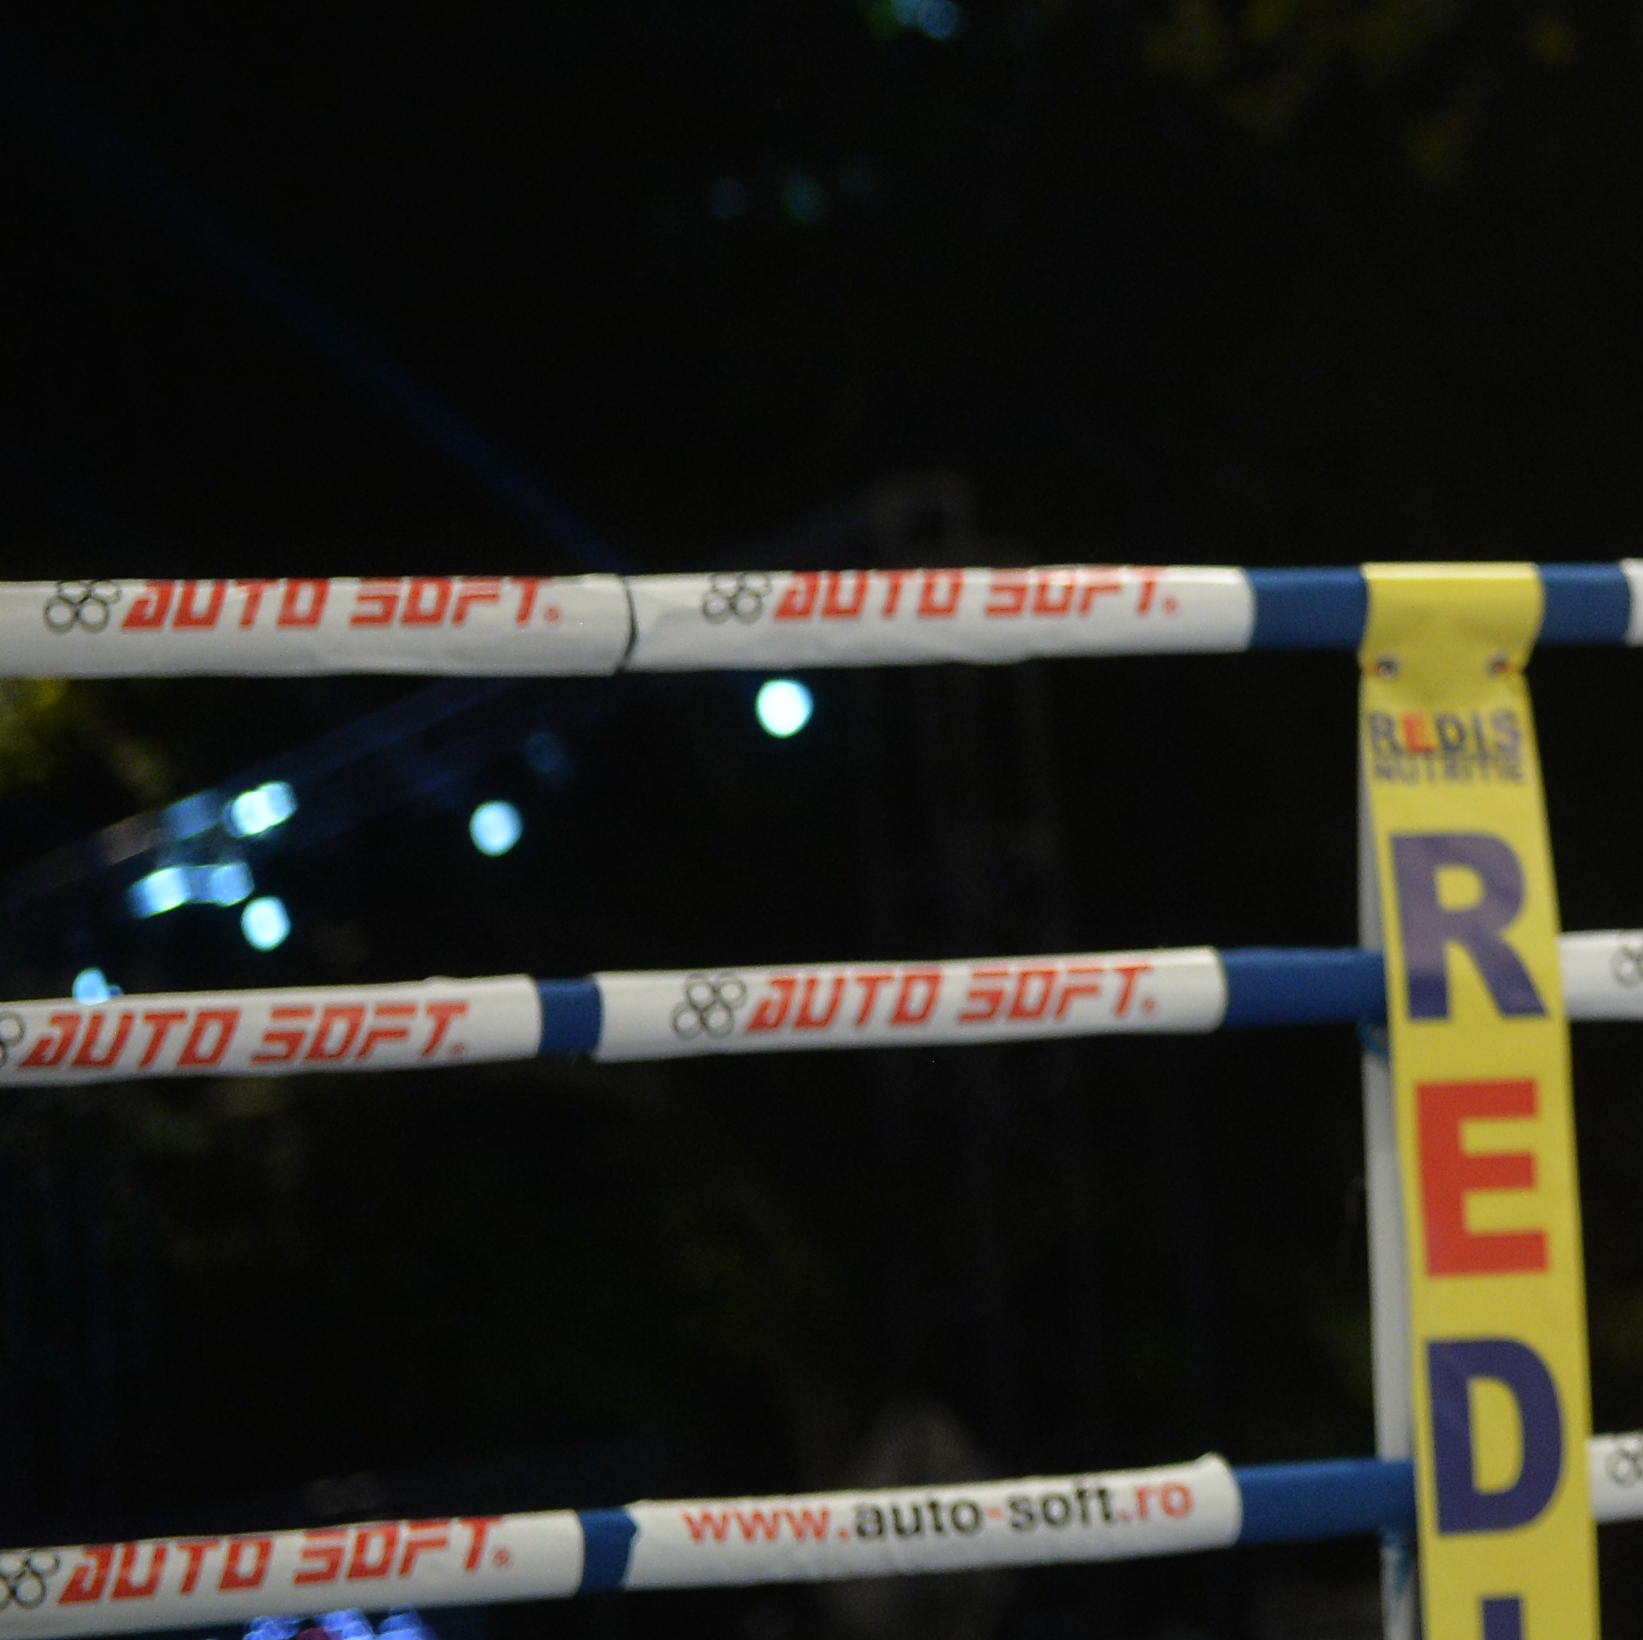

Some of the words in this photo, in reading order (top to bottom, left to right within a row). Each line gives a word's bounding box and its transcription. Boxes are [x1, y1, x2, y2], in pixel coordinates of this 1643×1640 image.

[122, 578, 330, 630] AUTO
[349, 576, 559, 627] SOFT
[773, 568, 964, 622] AUTO
[984, 566, 1163, 618] SOFT
[745, 965, 939, 1033] AUTO
[957, 961, 1154, 1023] SOFT
[19, 1007, 237, 1069] AUTO
[251, 1001, 470, 1064] SOFT
[681, 1481, 1193, 1543] www.auto-soft.ro
[58, 1534, 274, 1605] AUTO
[292, 1516, 508, 1587] SOFT
